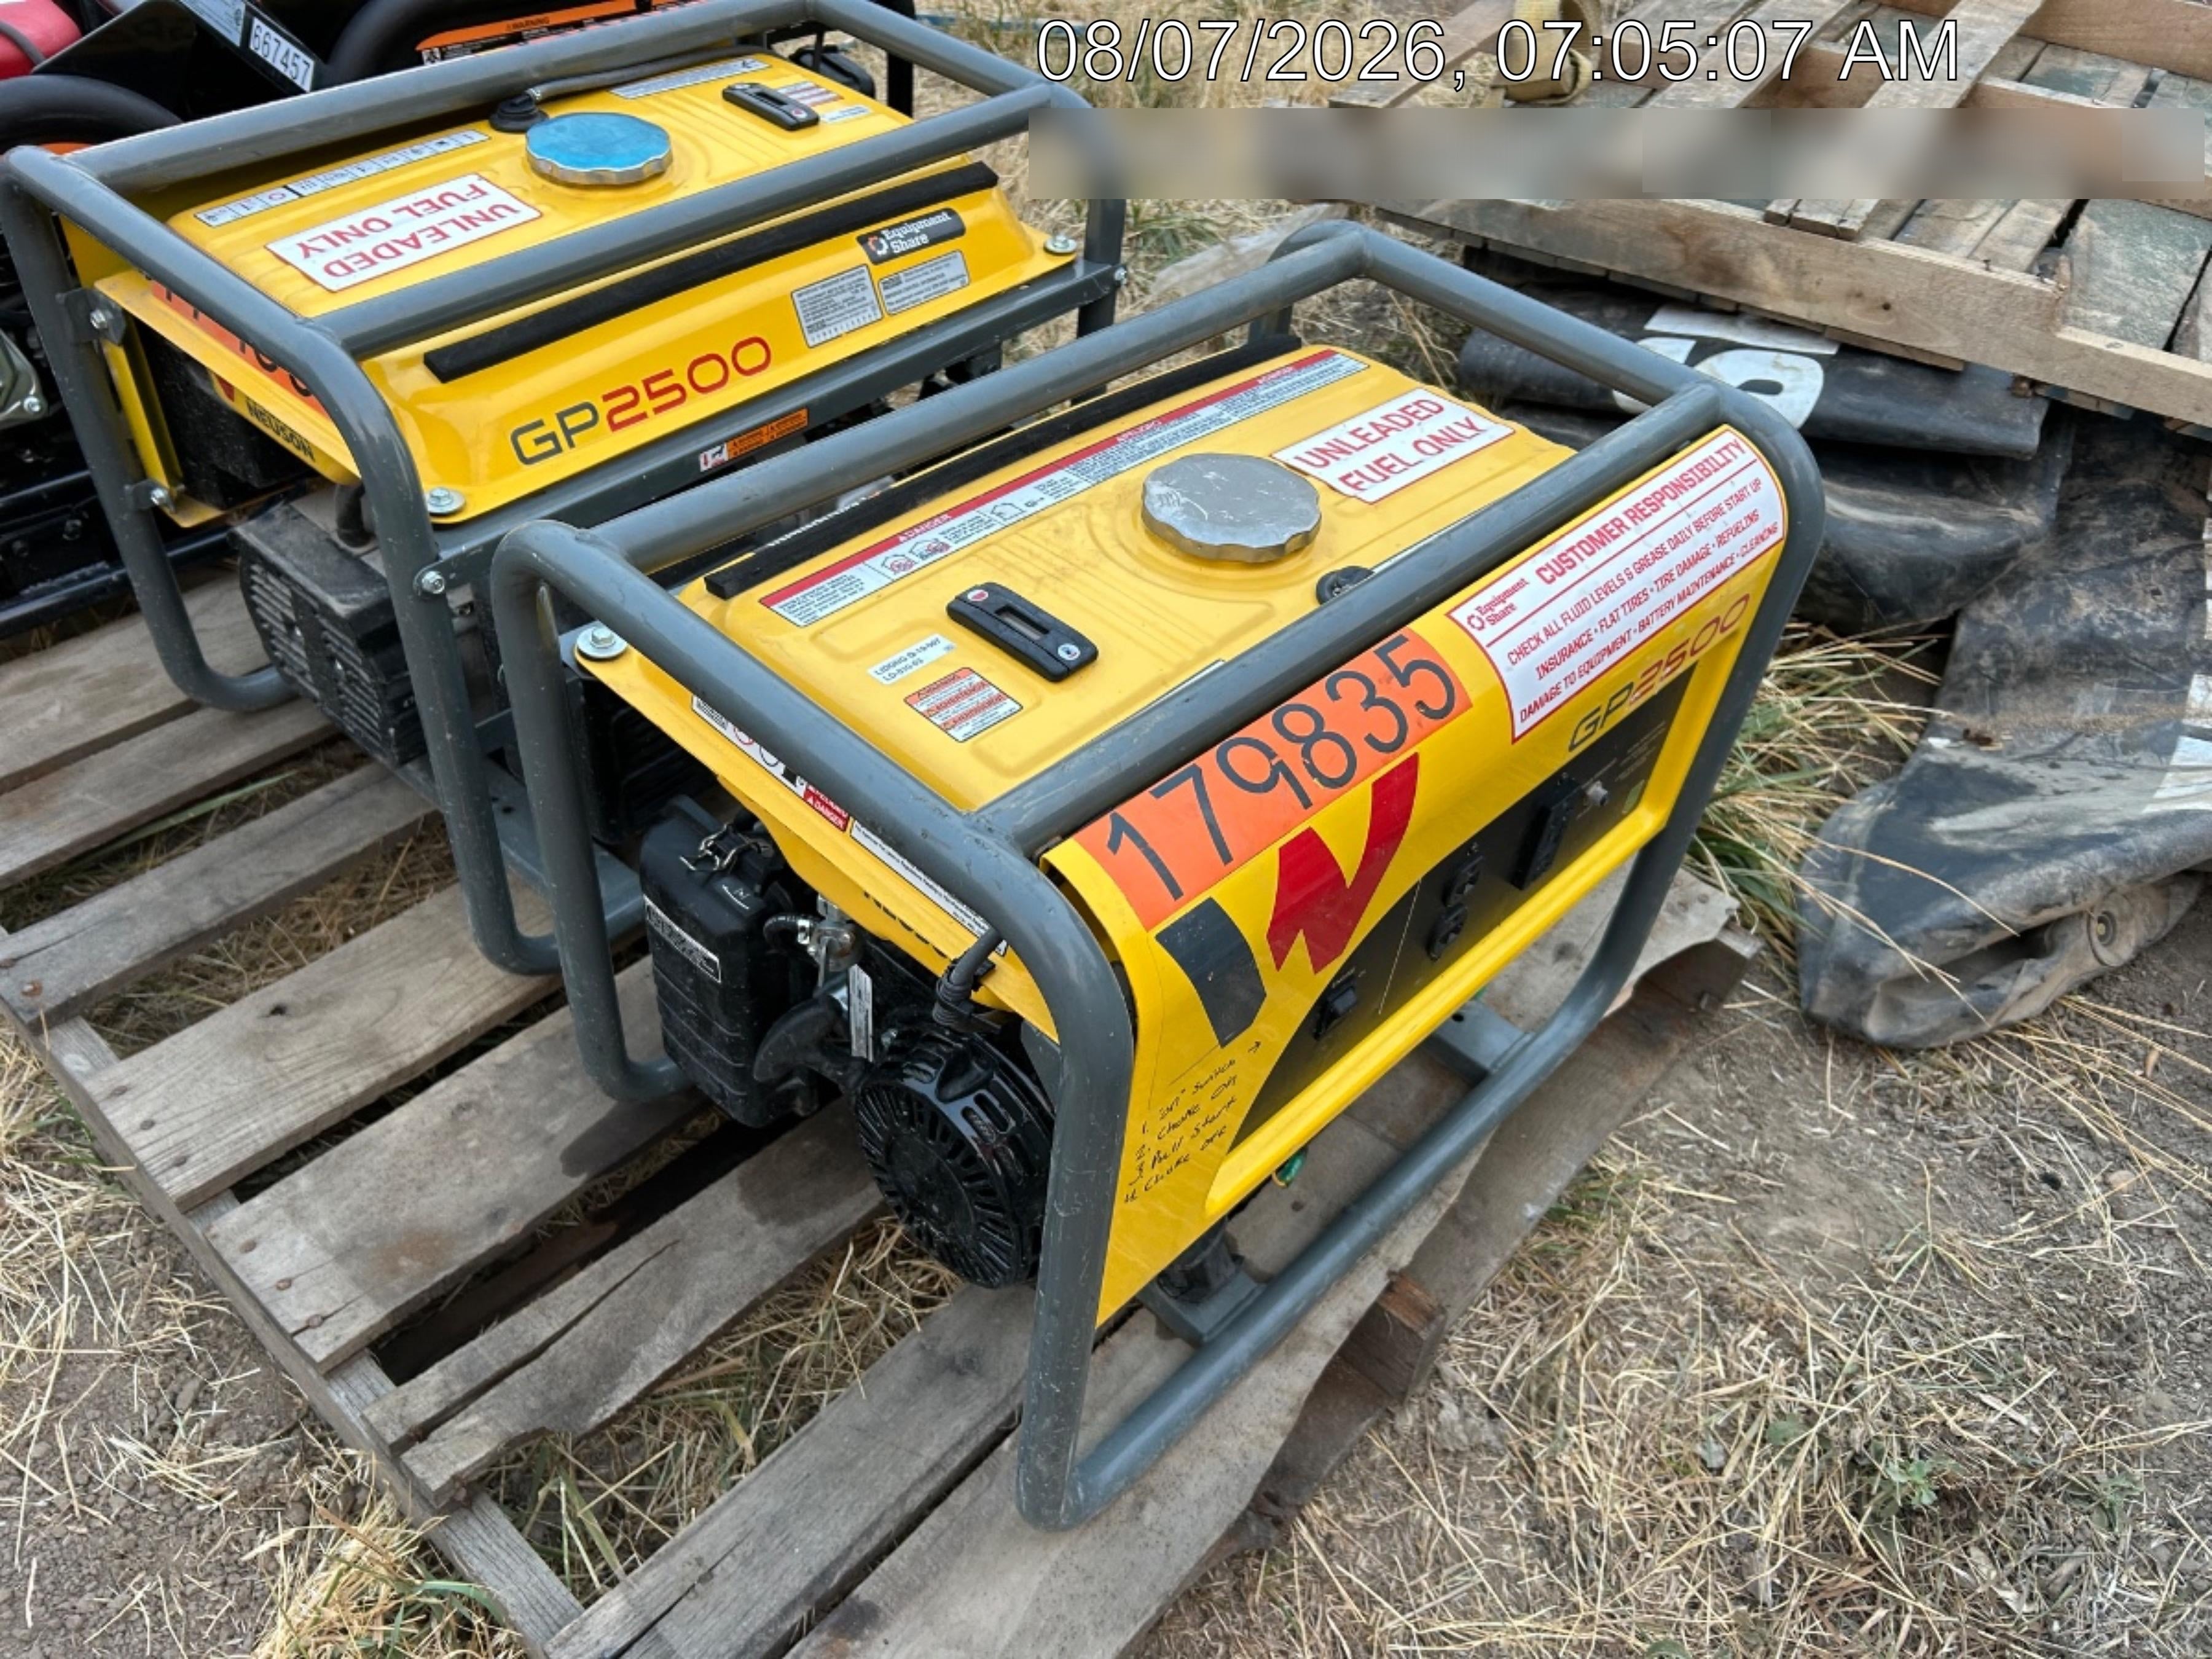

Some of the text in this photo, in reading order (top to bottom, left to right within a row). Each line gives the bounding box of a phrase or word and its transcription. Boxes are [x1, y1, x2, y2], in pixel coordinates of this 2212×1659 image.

[253, 25, 310, 85] 667457
[296, 183, 490, 259] FUEL ONLY
[323, 203, 520, 278] UNLEADED
[881, 211, 951, 241] Equipment
[890, 233, 929, 253] Share
[510, 336, 771, 465] GP2500
[1293, 399, 1444, 468] UNLEADED
[1338, 416, 1487, 491] FUEL ONLY
[1535, 439, 1747, 586] CUSTOMER RESPONSIBILITY
[1475, 578, 1530, 616] Equipment
[1507, 632, 1545, 666] CHECK
[1543, 619, 1564, 640] ALL
[1560, 597, 1592, 627] FLUID
[1592, 572, 1627, 605] LEVELS
[1632, 543, 1670, 575] GREASE
[1667, 524, 1695, 551] DAILY
[1692, 502, 1727, 533] BEFORE
[1723, 485, 1752, 512] START
[1749, 476, 1762, 493] UP
[1535, 508, 1760, 681] INSURANCE FLAT TIRES TIRE DAMAGE REFUELING
[1485, 603, 1517, 626] Share
[1520, 520, 1779, 724] DAMAGE TO EQUIPMENT BATTERY MAINTENANCE CLEANING
[1568, 593, 1751, 753] GP2500
[1107, 633, 1456, 902] 179835
